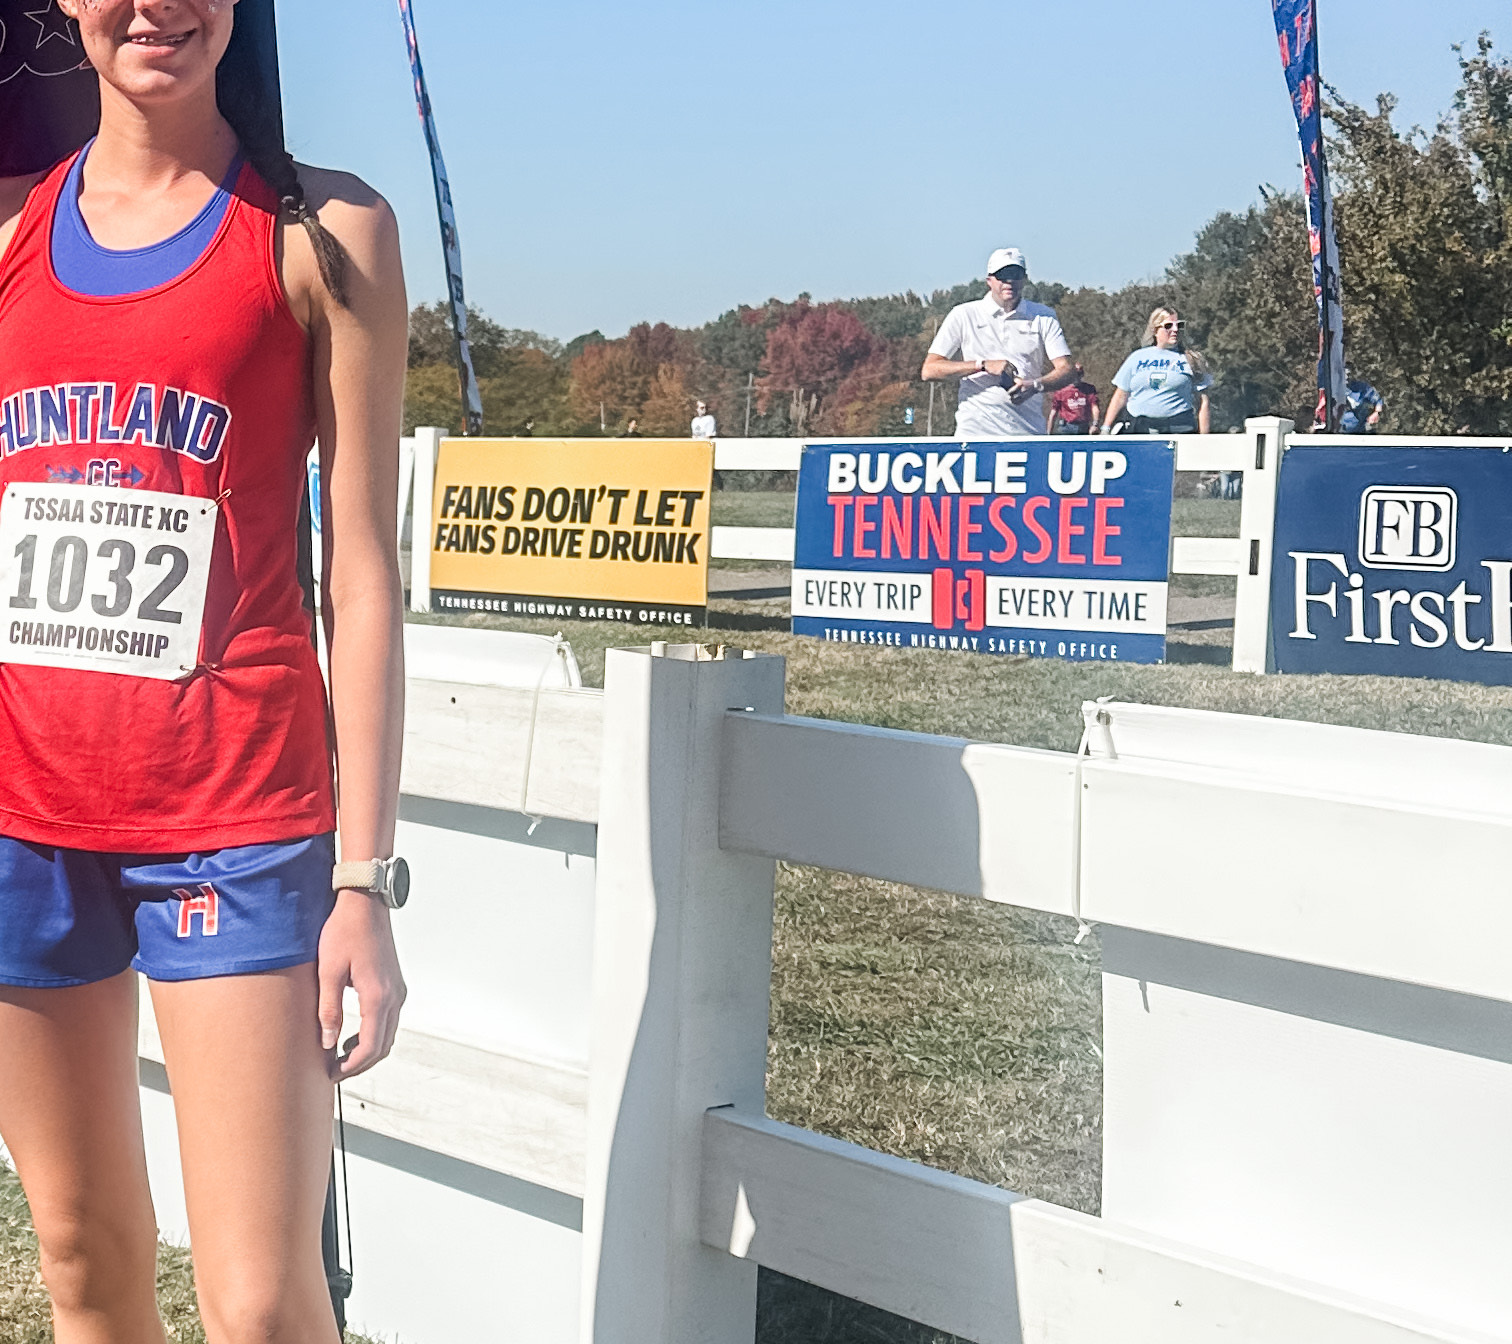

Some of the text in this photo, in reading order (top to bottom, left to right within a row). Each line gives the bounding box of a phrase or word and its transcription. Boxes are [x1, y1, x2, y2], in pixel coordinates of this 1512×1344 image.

[827, 451, 1128, 495] BUCKLE UP
[24, 497, 190, 534] TSSAA STATE XC
[440, 485, 705, 528] FANS DON'T LET
[1369, 498, 1444, 558] FB
[434, 524, 702, 565] FANS DRIVE DRUNK
[826, 495, 1126, 566] TENNESSEE
[8, 534, 190, 625] 1032
[804, 579, 1148, 622] EVERY TRIP EVERY TIME
[438, 595, 693, 626] TENNESSEE HIGHWAY SAFETY OFFICE
[9, 620, 170, 660] CHAMPIONSHIP
[824, 627, 1119, 660] TENNESSEE HIGHWAY SAFETY OFFICE
